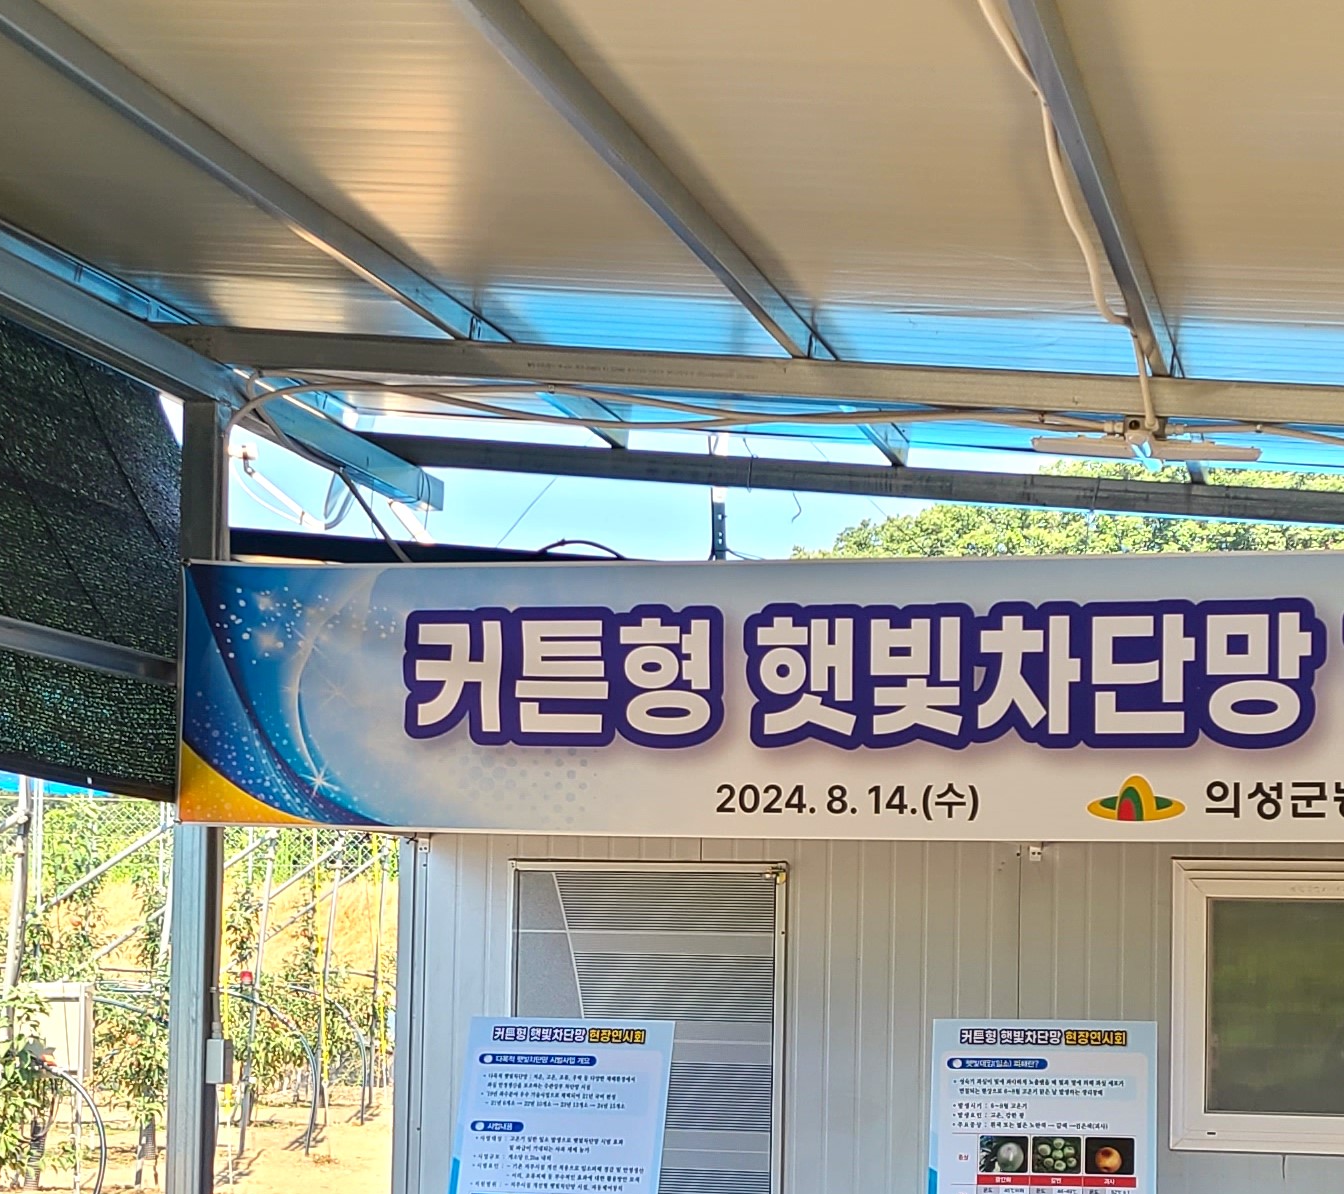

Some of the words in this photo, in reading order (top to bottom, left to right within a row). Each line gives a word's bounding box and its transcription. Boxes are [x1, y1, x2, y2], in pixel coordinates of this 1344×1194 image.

[404, 603, 721, 747] 커튼형
[743, 596, 1327, 747] 햇빛차단망
[714, 783, 818, 815] 2024.
[826, 783, 859, 815] 8.
[866, 781, 980, 821] 14.(수)
[493, 1026, 527, 1041] 커튼형
[529, 1027, 586, 1042] 햇빛차단망
[588, 1028, 646, 1043] 현장연시회
[960, 1029, 997, 1044] 커튼형
[1000, 1029, 1062, 1044] 햇빛차단망
[1064, 1030, 1128, 1046] 현장연시회
[517, 1056, 548, 1064] 햇빛차단망
[487, 1122, 513, 1131] 사업내용
